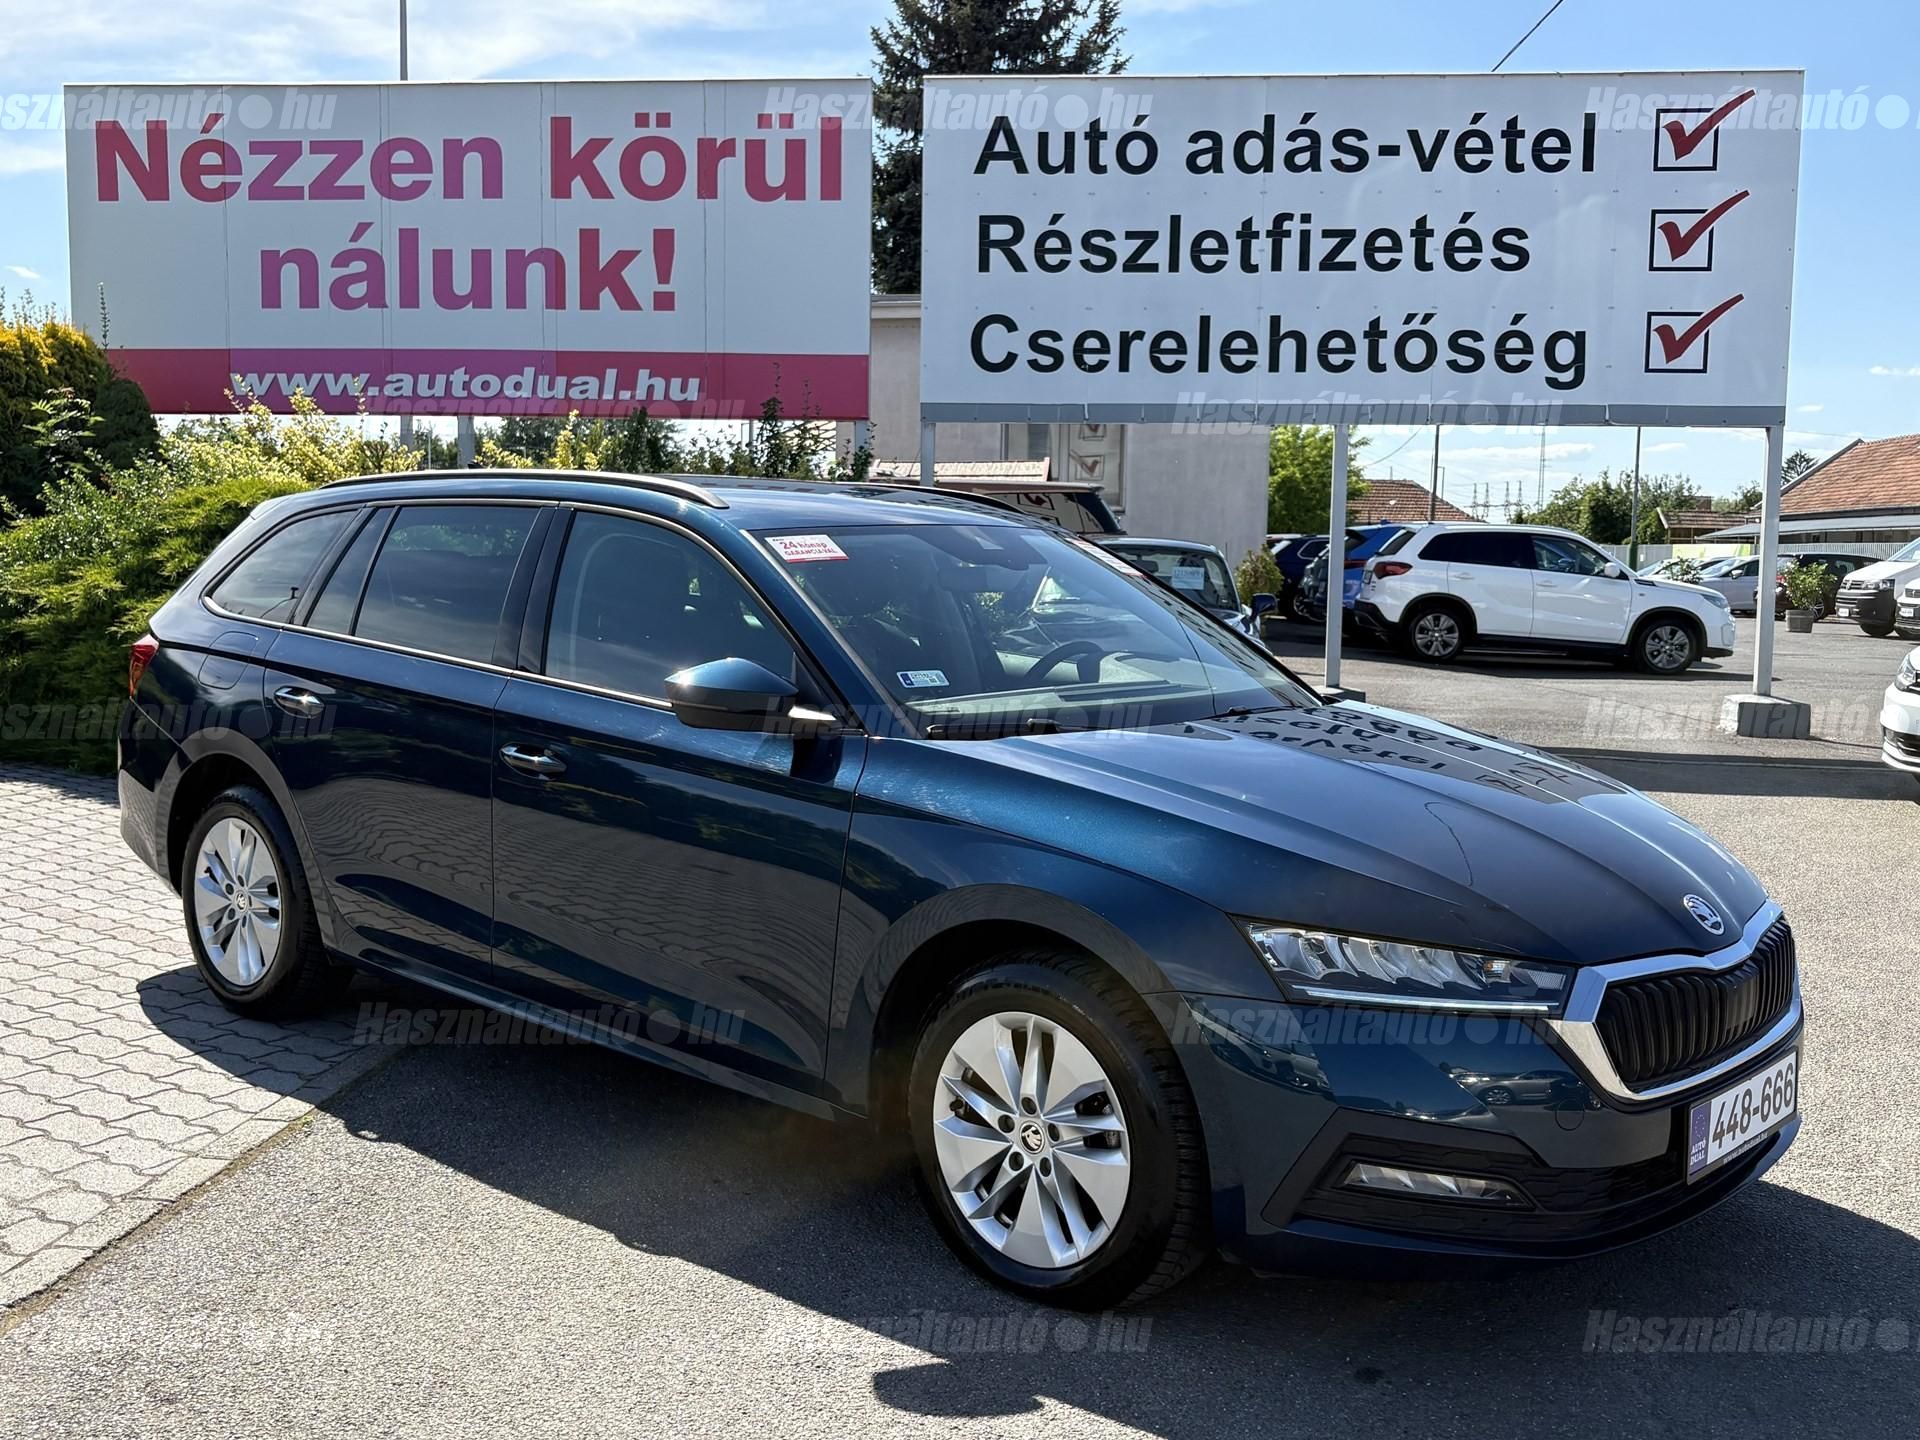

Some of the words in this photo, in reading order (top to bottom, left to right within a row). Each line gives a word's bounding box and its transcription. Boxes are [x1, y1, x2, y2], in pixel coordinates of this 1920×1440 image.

[95, 113, 504, 202] Nézzen
[550, 112, 842, 202] körül
[974, 114, 1159, 176] Autó
[1185, 111, 1596, 175] adás-vétel
[260, 222, 676, 312] nálunk!
[978, 211, 1530, 274] Részletfizetés
[229, 365, 700, 401] www.autodual.hu
[970, 312, 1586, 390] Cserelehetőség
[1712, 1062, 1794, 1149] 448-666
